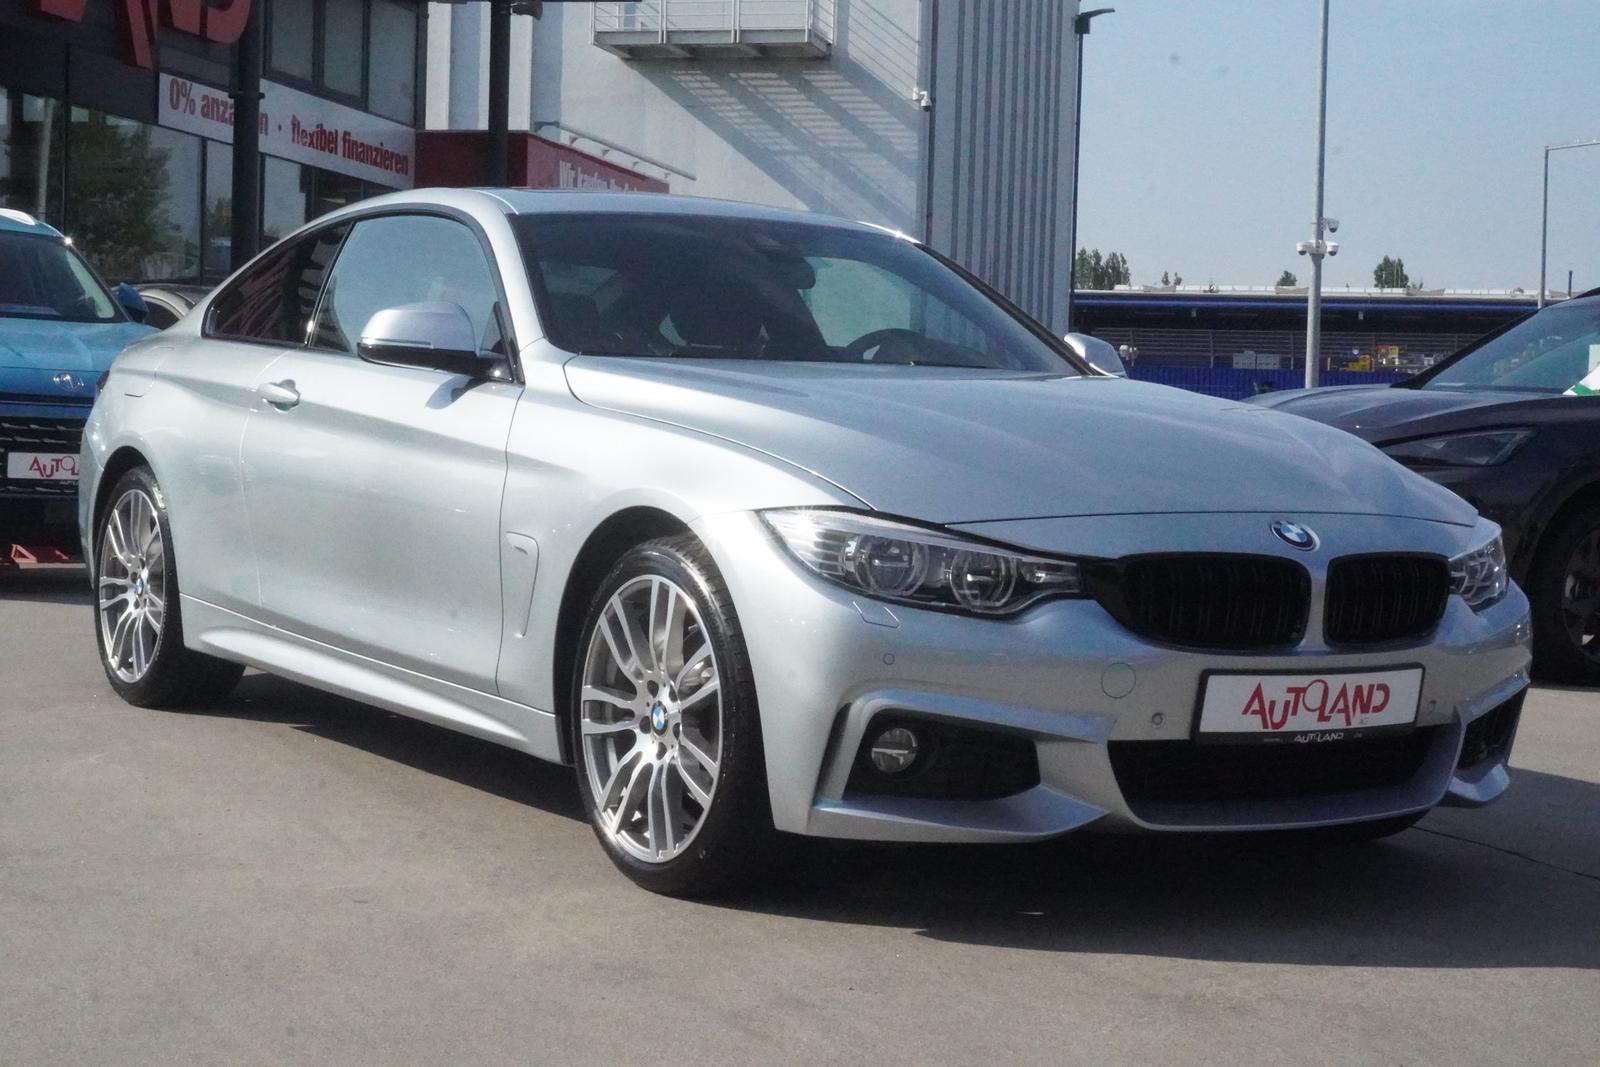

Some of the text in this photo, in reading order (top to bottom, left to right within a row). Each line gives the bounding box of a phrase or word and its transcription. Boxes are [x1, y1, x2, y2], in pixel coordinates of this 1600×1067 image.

[169, 78, 196, 115] 0%
[291, 113, 339, 155] flexibel
[342, 129, 409, 176] finanzieren
[28, 455, 80, 478] AUTOL
[1241, 678, 1390, 730] AUTOLAND
